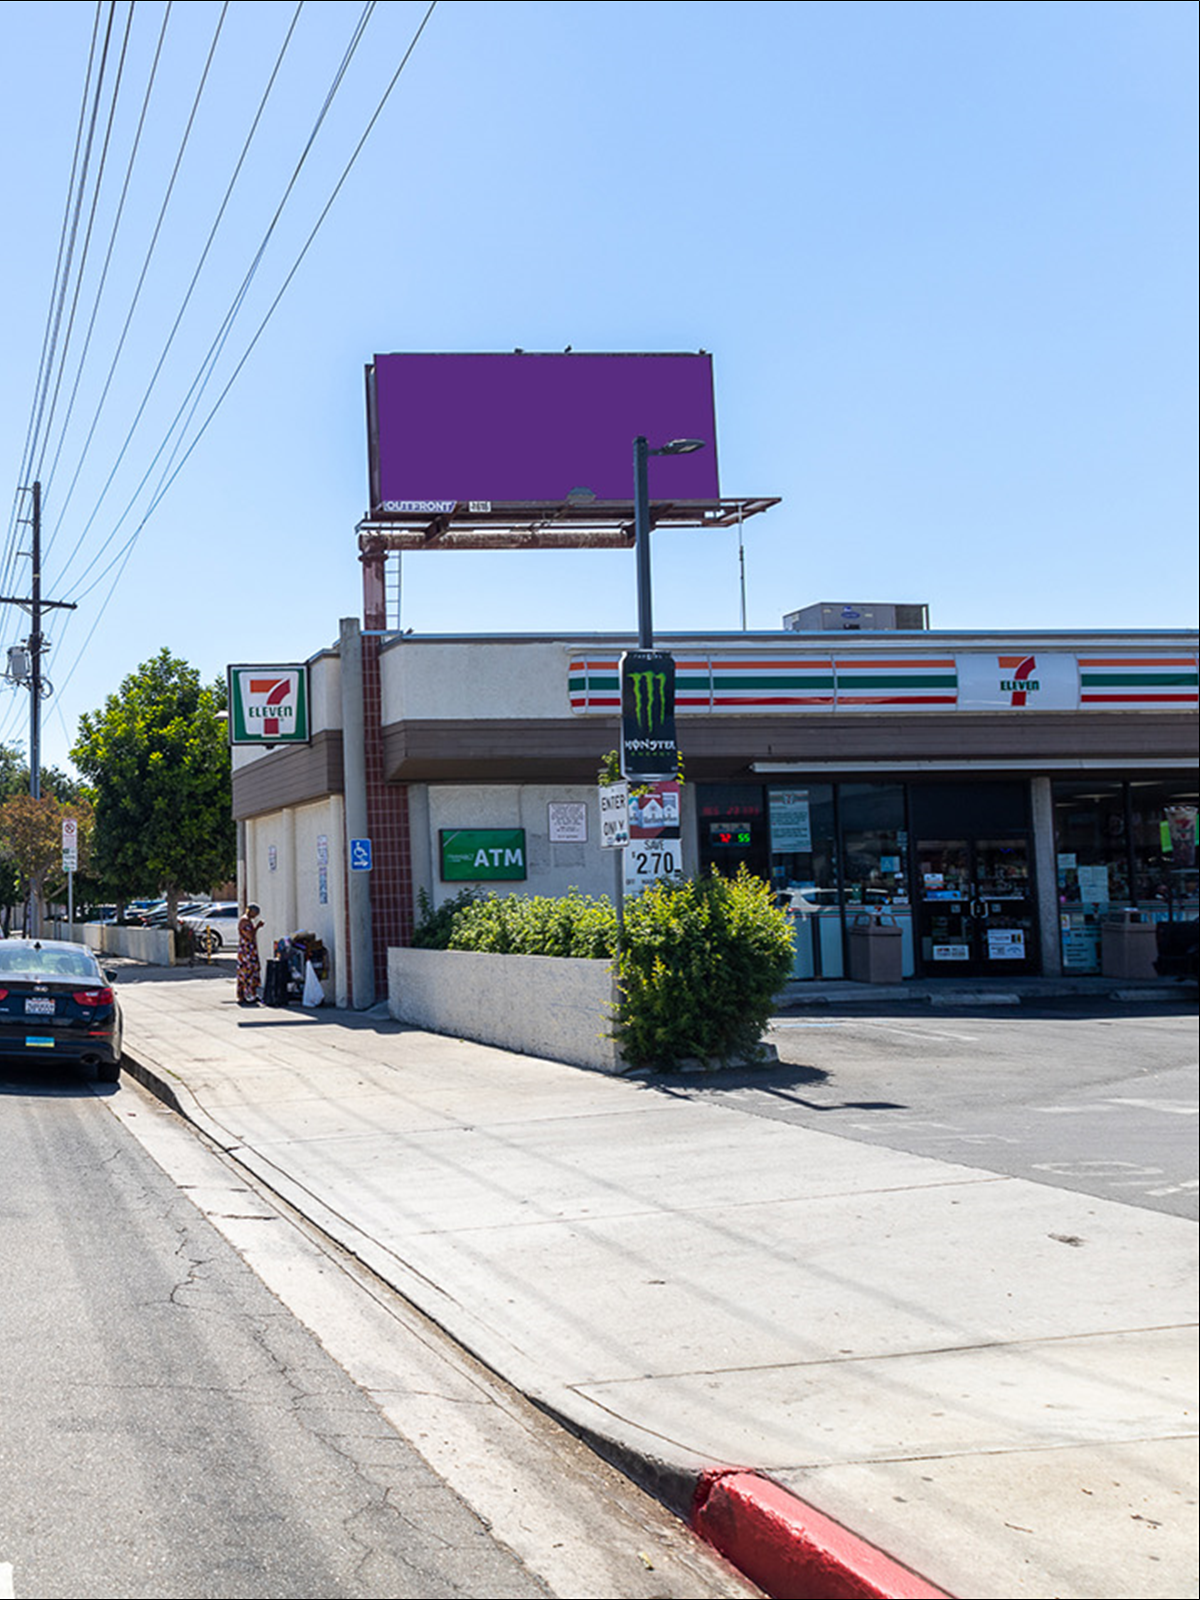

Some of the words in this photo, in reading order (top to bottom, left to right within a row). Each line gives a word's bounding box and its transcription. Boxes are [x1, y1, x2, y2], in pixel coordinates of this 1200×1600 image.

[386, 500, 452, 512] OUTFRONT
[997, 656, 1036, 706] 7
[1000, 680, 1039, 691] ELEVEN
[248, 706, 293, 718] ELEVEN
[250, 679, 290, 734] 7
[625, 739, 676, 751] MONSTER
[602, 794, 626, 811] ENTER
[603, 820, 625, 836] ONLY
[644, 840, 664, 850] SAVE
[473, 848, 523, 867] ATM
